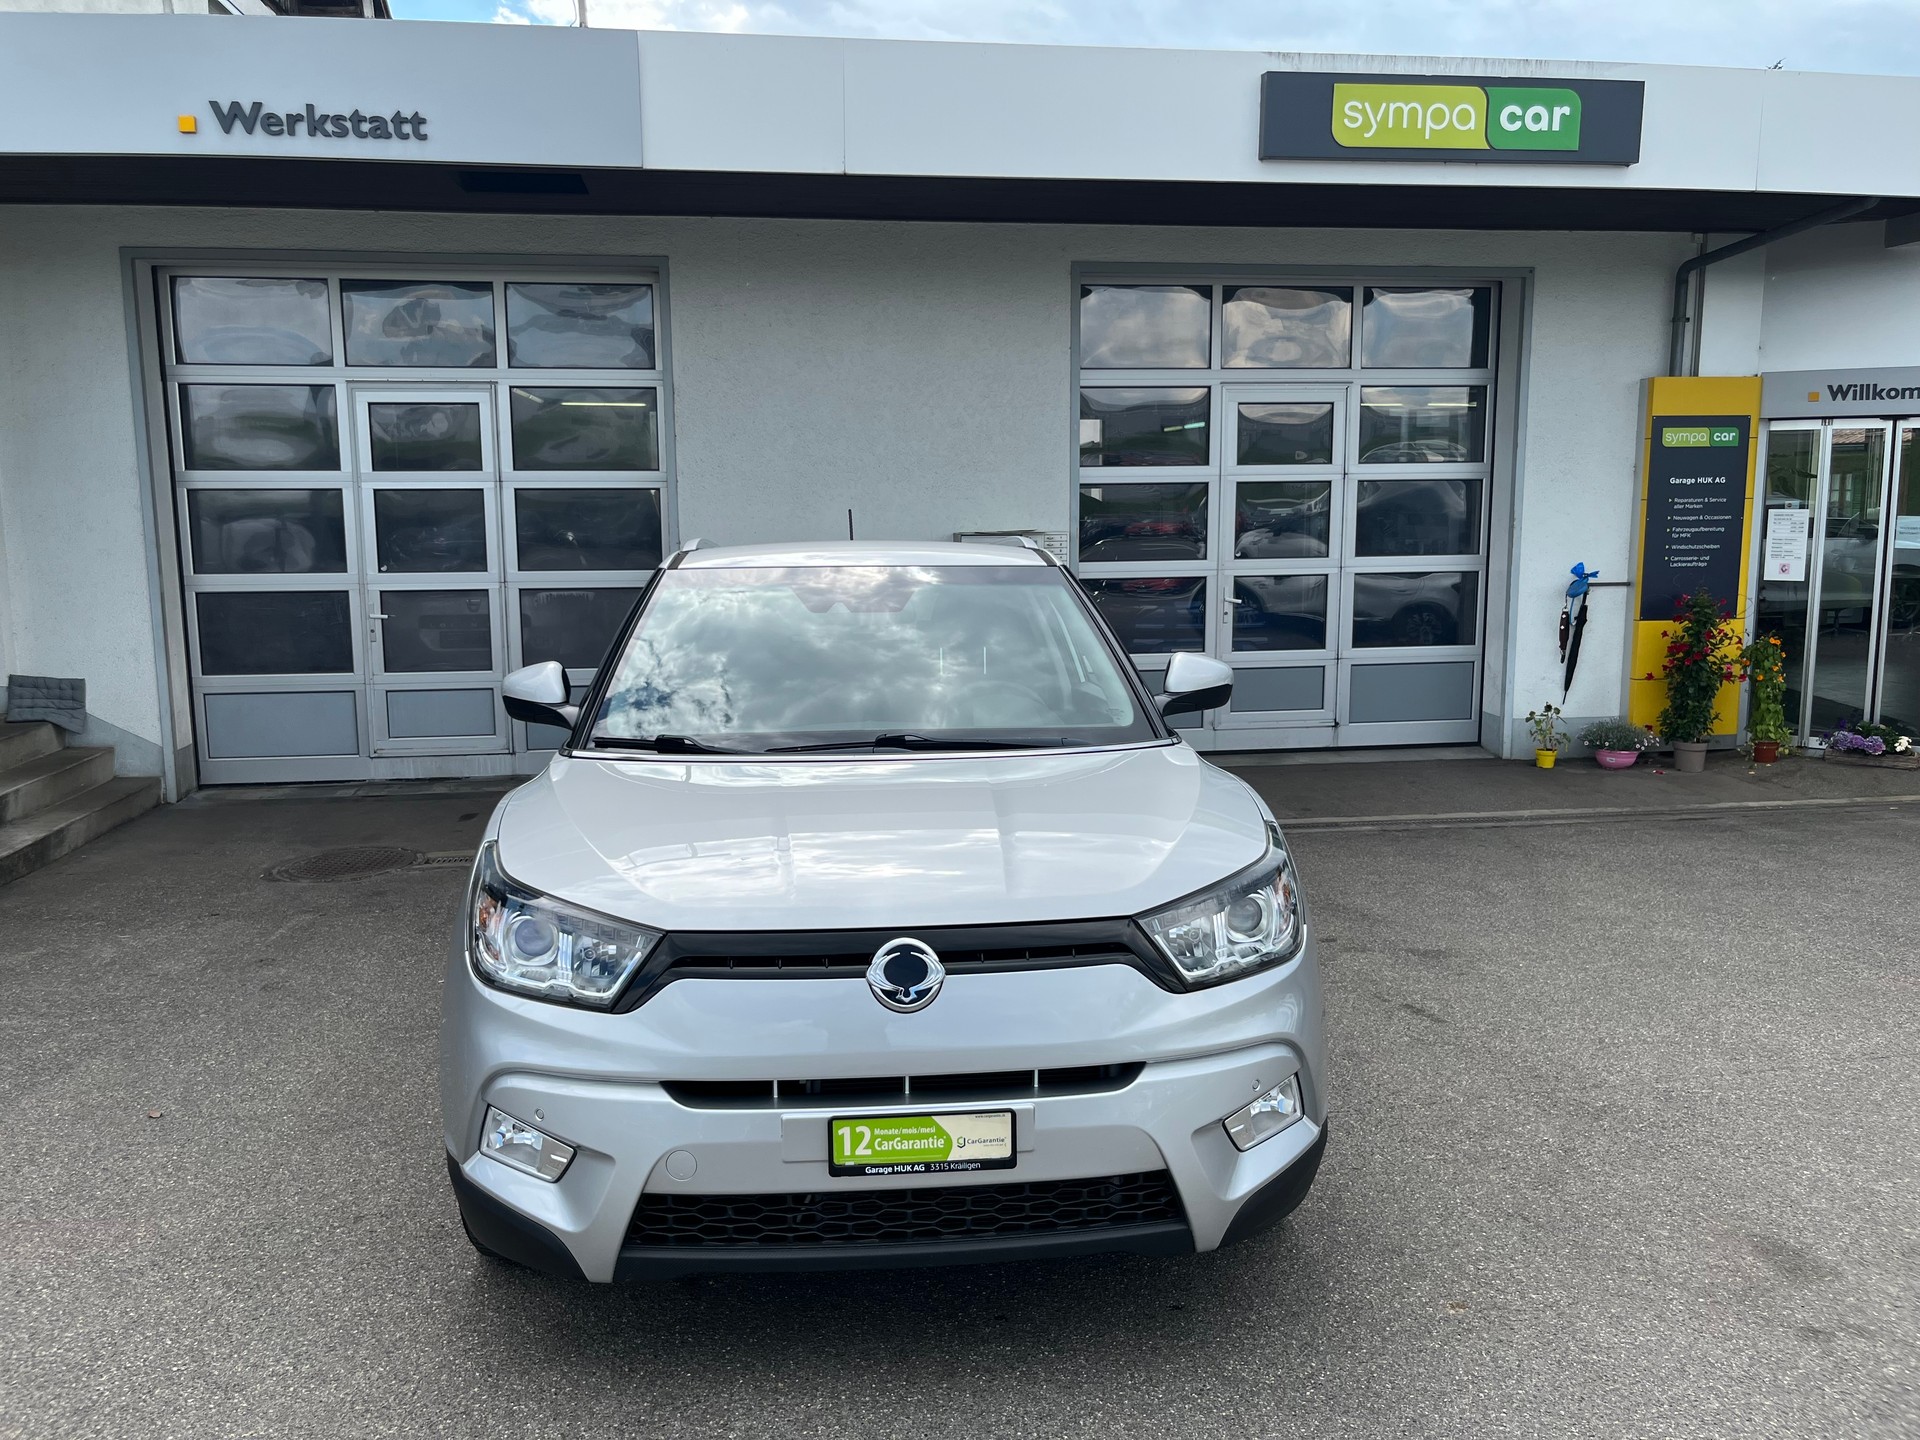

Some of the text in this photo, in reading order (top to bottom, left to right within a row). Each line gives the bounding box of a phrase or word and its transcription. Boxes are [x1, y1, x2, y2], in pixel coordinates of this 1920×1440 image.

[208, 100, 428, 141] Werkstatt
[1343, 100, 1570, 139] sympa car
[1665, 432, 1736, 445] sympa car
[1669, 477, 1696, 485] Garage
[1714, 476, 1726, 484] AG
[874, 1126, 936, 1136] Monate/mois/mesi
[838, 1125, 872, 1156] 12
[865, 1166, 893, 1174] Garage
[894, 1164, 913, 1173] HUK
[914, 1164, 926, 1172] AG
[930, 1162, 949, 1170] 3315
